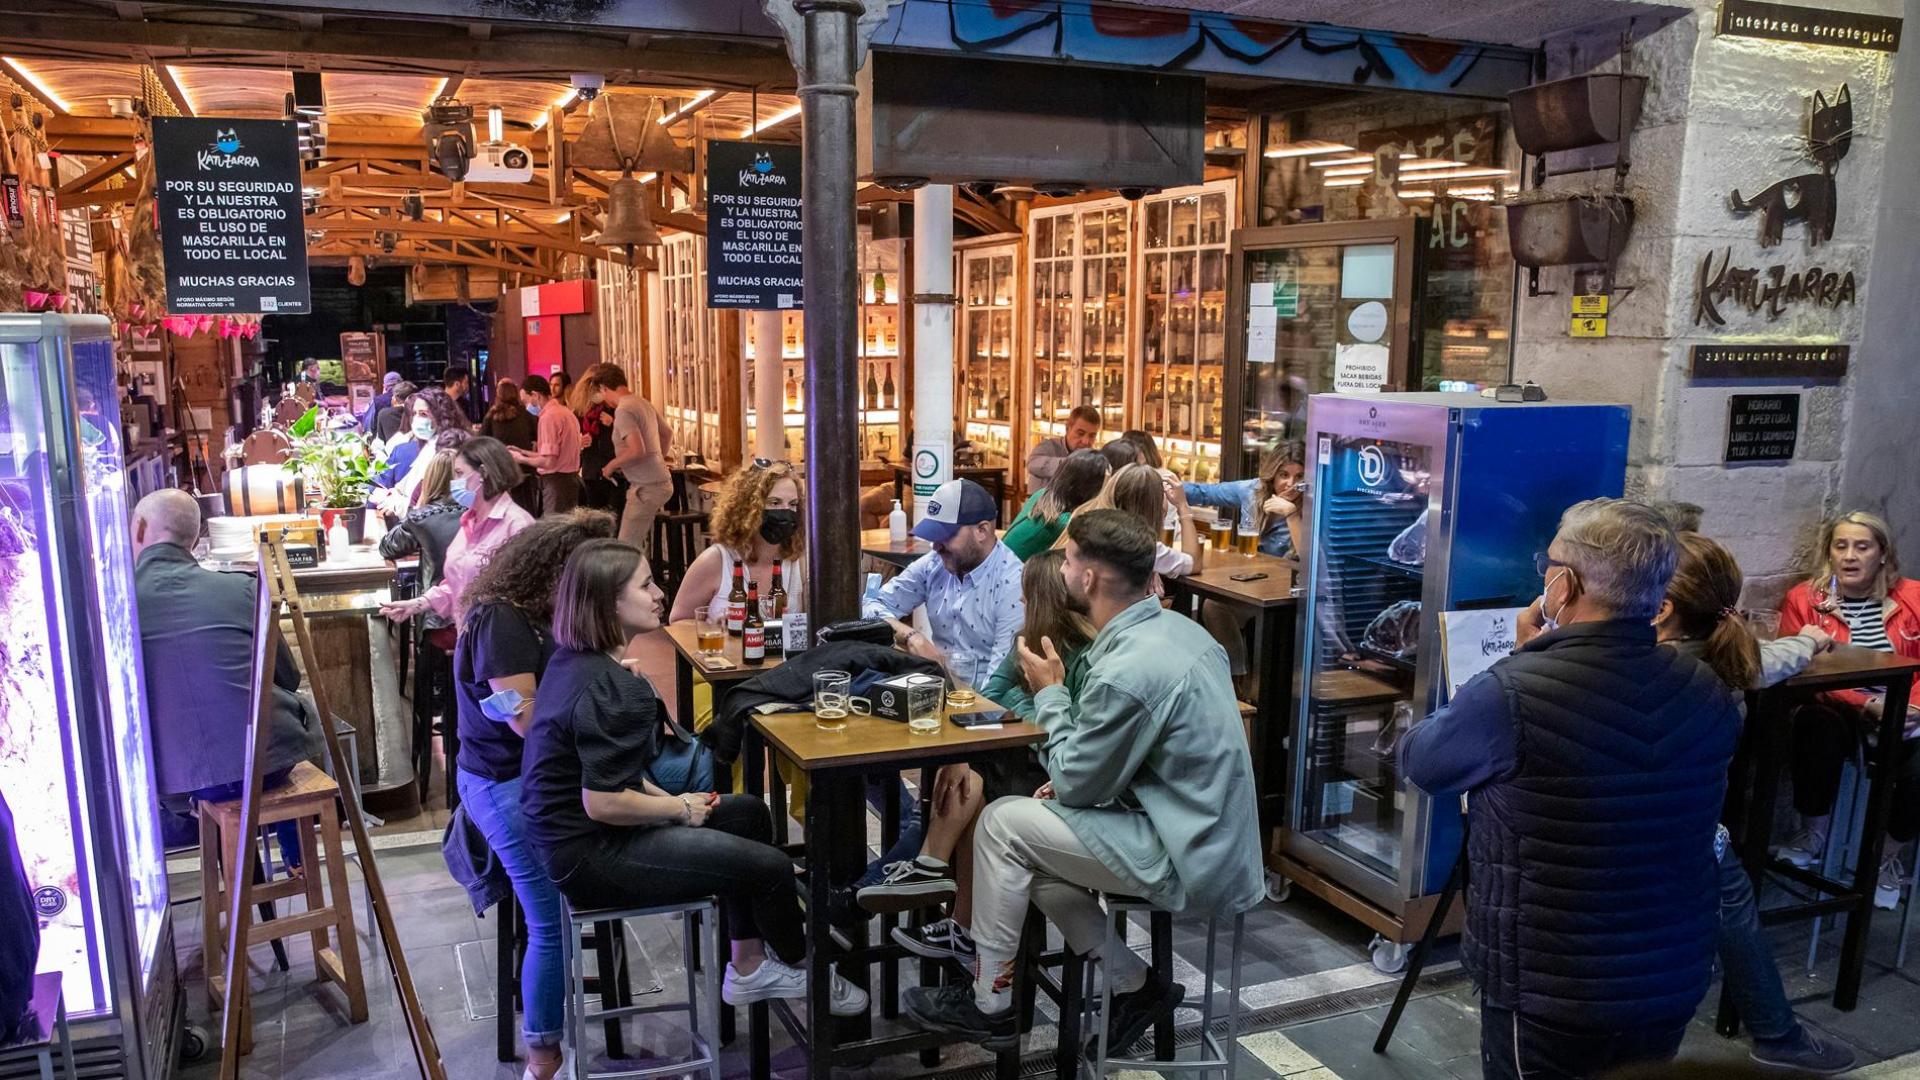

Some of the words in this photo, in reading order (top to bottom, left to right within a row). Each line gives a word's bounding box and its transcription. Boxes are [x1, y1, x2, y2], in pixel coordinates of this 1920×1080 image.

[1729, 12, 1799, 33] jatetxea
[1812, 26, 1895, 44] erreteguia
[165, 180, 194, 192] POR
[197, 181, 215, 192] SU
[218, 181, 294, 193] SEGURIDAD
[184, 194, 193, 206] Y
[196, 195, 213, 206] LA
[216, 195, 278, 207] NUESTRA
[713, 194, 735, 204] POR
[737, 195, 751, 205] SU
[178, 208, 195, 219] ES
[198, 208, 287, 220] OBLIGATORIO
[726, 206, 734, 216] Y
[736, 208, 749, 216] LA
[751, 208, 798, 218] NUESTRA
[200, 222, 216, 233] EL
[219, 222, 247, 233] USO
[250, 222, 268, 233] DE
[720, 218, 734, 227] ES
[736, 219, 803, 230] OBLIGATORIO
[182, 235, 266, 247] MASCARILLA
[268, 235, 286, 247] EN
[736, 230, 749, 239] EL
[751, 231, 773, 241] USO
[775, 232, 789, 241] DE
[722, 241, 787, 252] MASCARILLA
[788, 244, 802, 253] EN
[184, 249, 221, 260] TODO
[224, 249, 241, 260] EL
[244, 249, 287, 260] LOCAL
[723, 253, 752, 262] TODO
[754, 254, 766, 263] EL
[768, 255, 802, 264] LOCAL
[179, 276, 235, 287] MUCHAS
[238, 276, 295, 287] GRACIAS
[717, 276, 761, 286] MUCHAS
